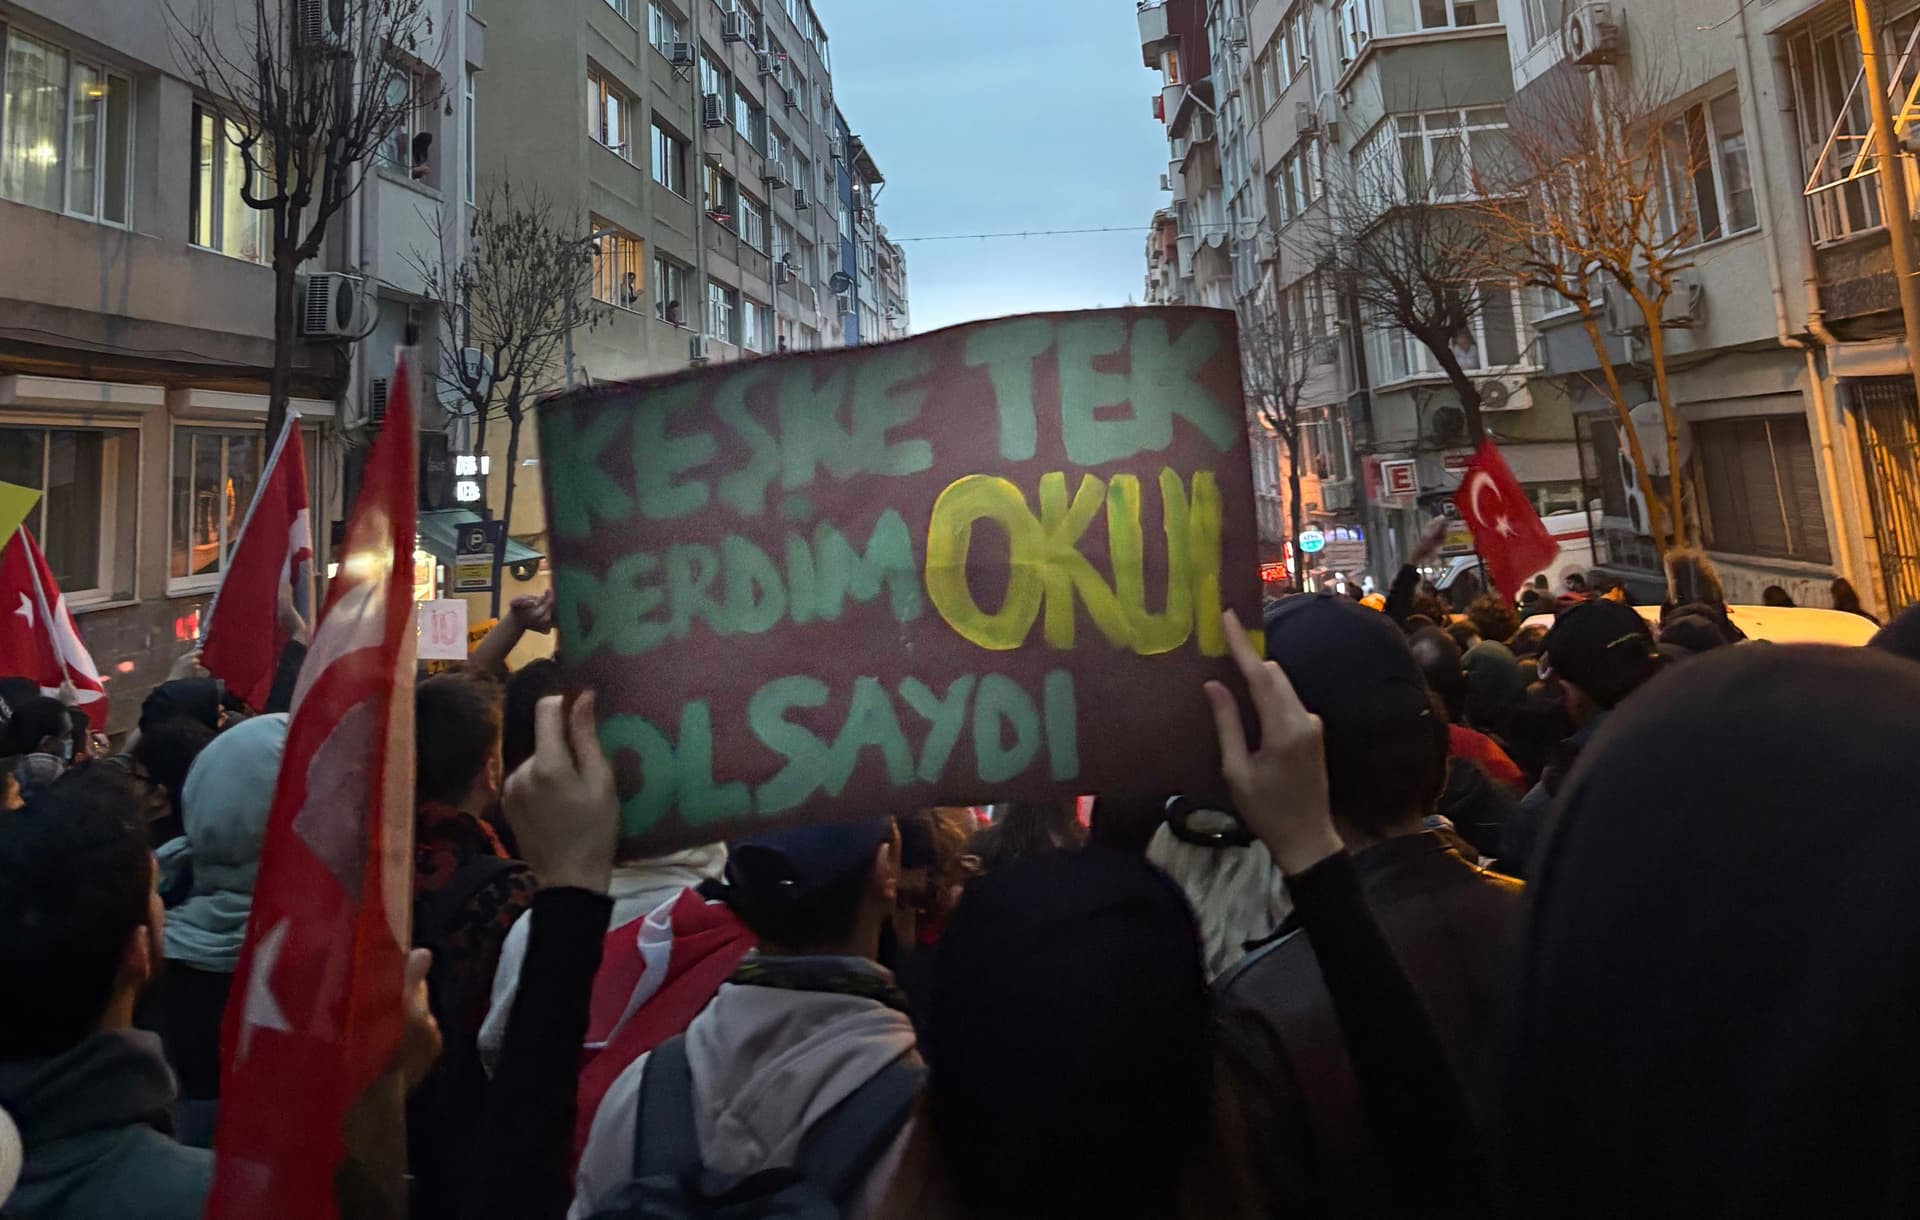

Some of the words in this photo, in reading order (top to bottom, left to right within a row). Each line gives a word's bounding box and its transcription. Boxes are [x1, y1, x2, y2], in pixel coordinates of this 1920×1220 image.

[544, 351, 933, 537] KEŞKE
[966, 319, 1242, 466] TEK
[1392, 468, 1411, 491] E
[471, 534, 484, 547] P
[557, 492, 922, 663] DERDİM
[926, 468, 1265, 657] OKUL
[599, 669, 1079, 837] OLSAYDI
